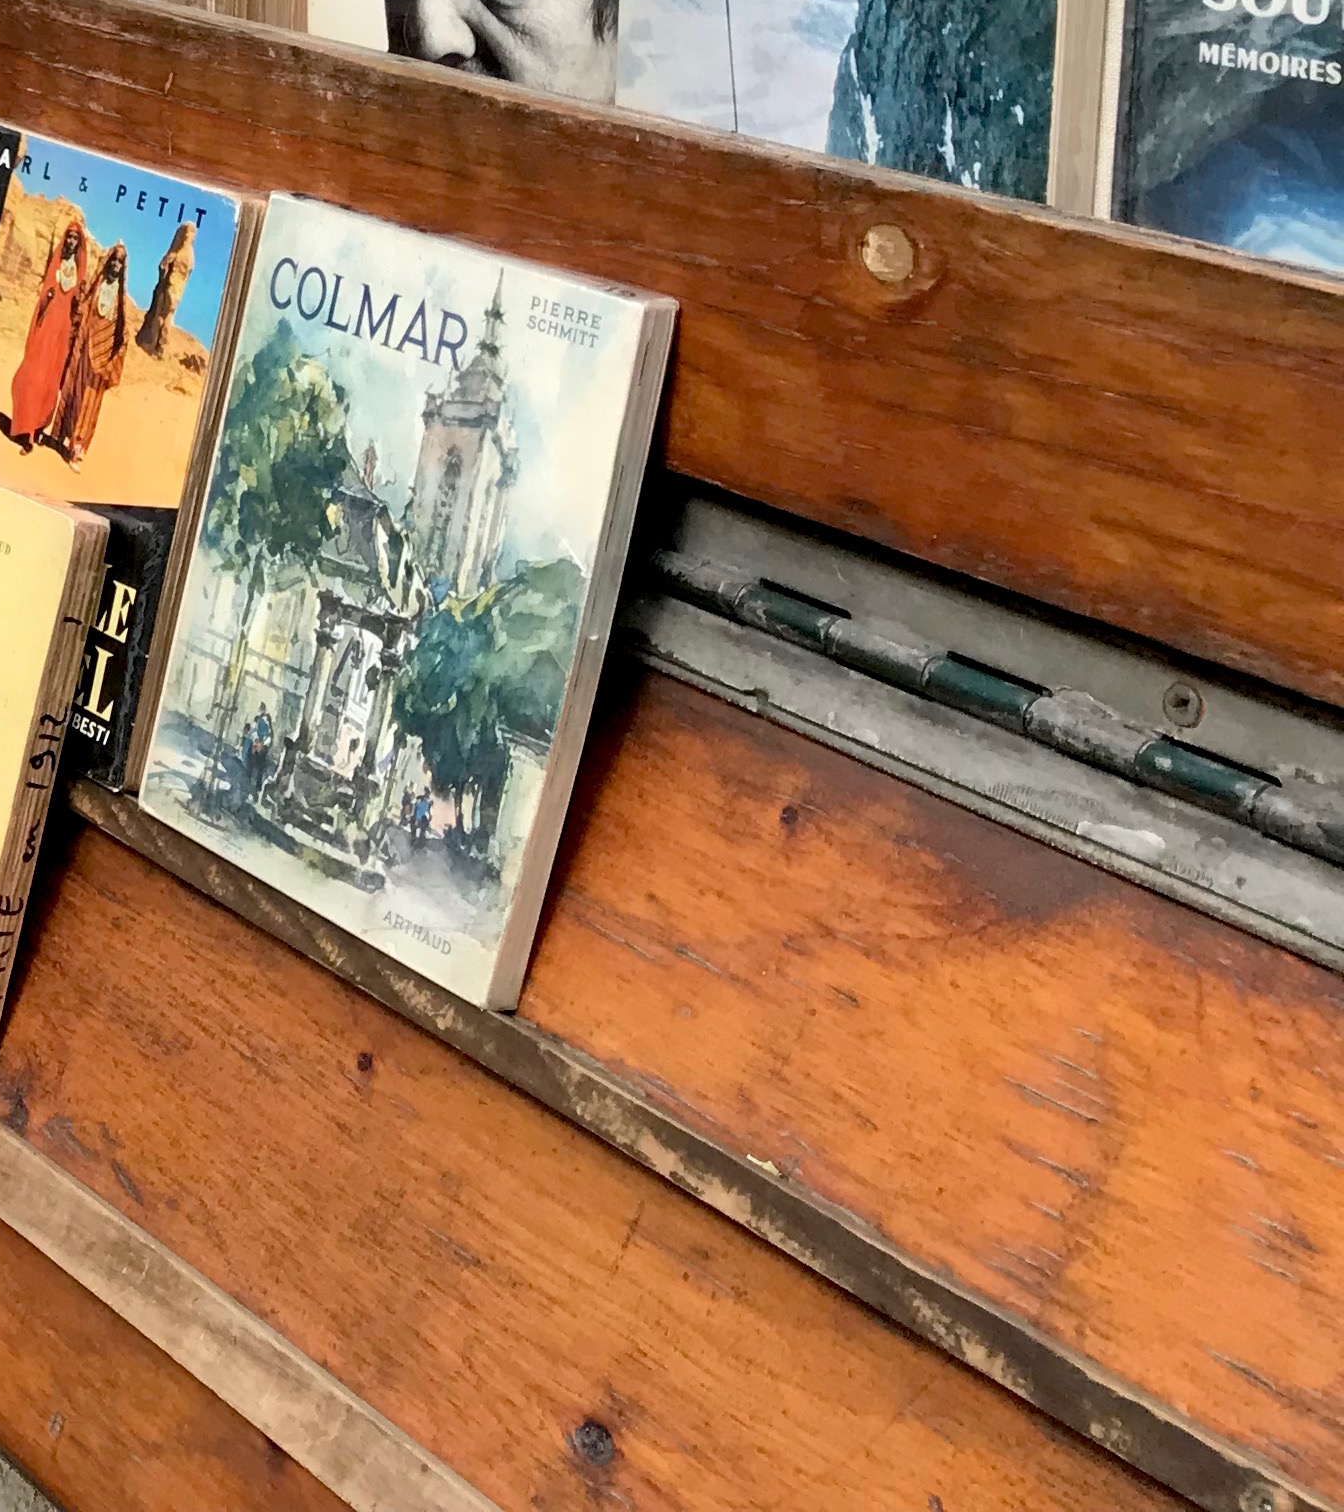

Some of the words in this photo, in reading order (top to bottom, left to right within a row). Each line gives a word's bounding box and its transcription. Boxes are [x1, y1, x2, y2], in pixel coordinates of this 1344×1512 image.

[1198, 40, 1343, 86] MÉMOIRES
[78, 176, 90, 193] &
[115, 184, 209, 229] PETIT
[269, 256, 469, 372] COLMAR
[525, 314, 600, 350] SCHMITT
[529, 295, 604, 332] PIERRE
[382, 907, 452, 958] ARTHAUD
